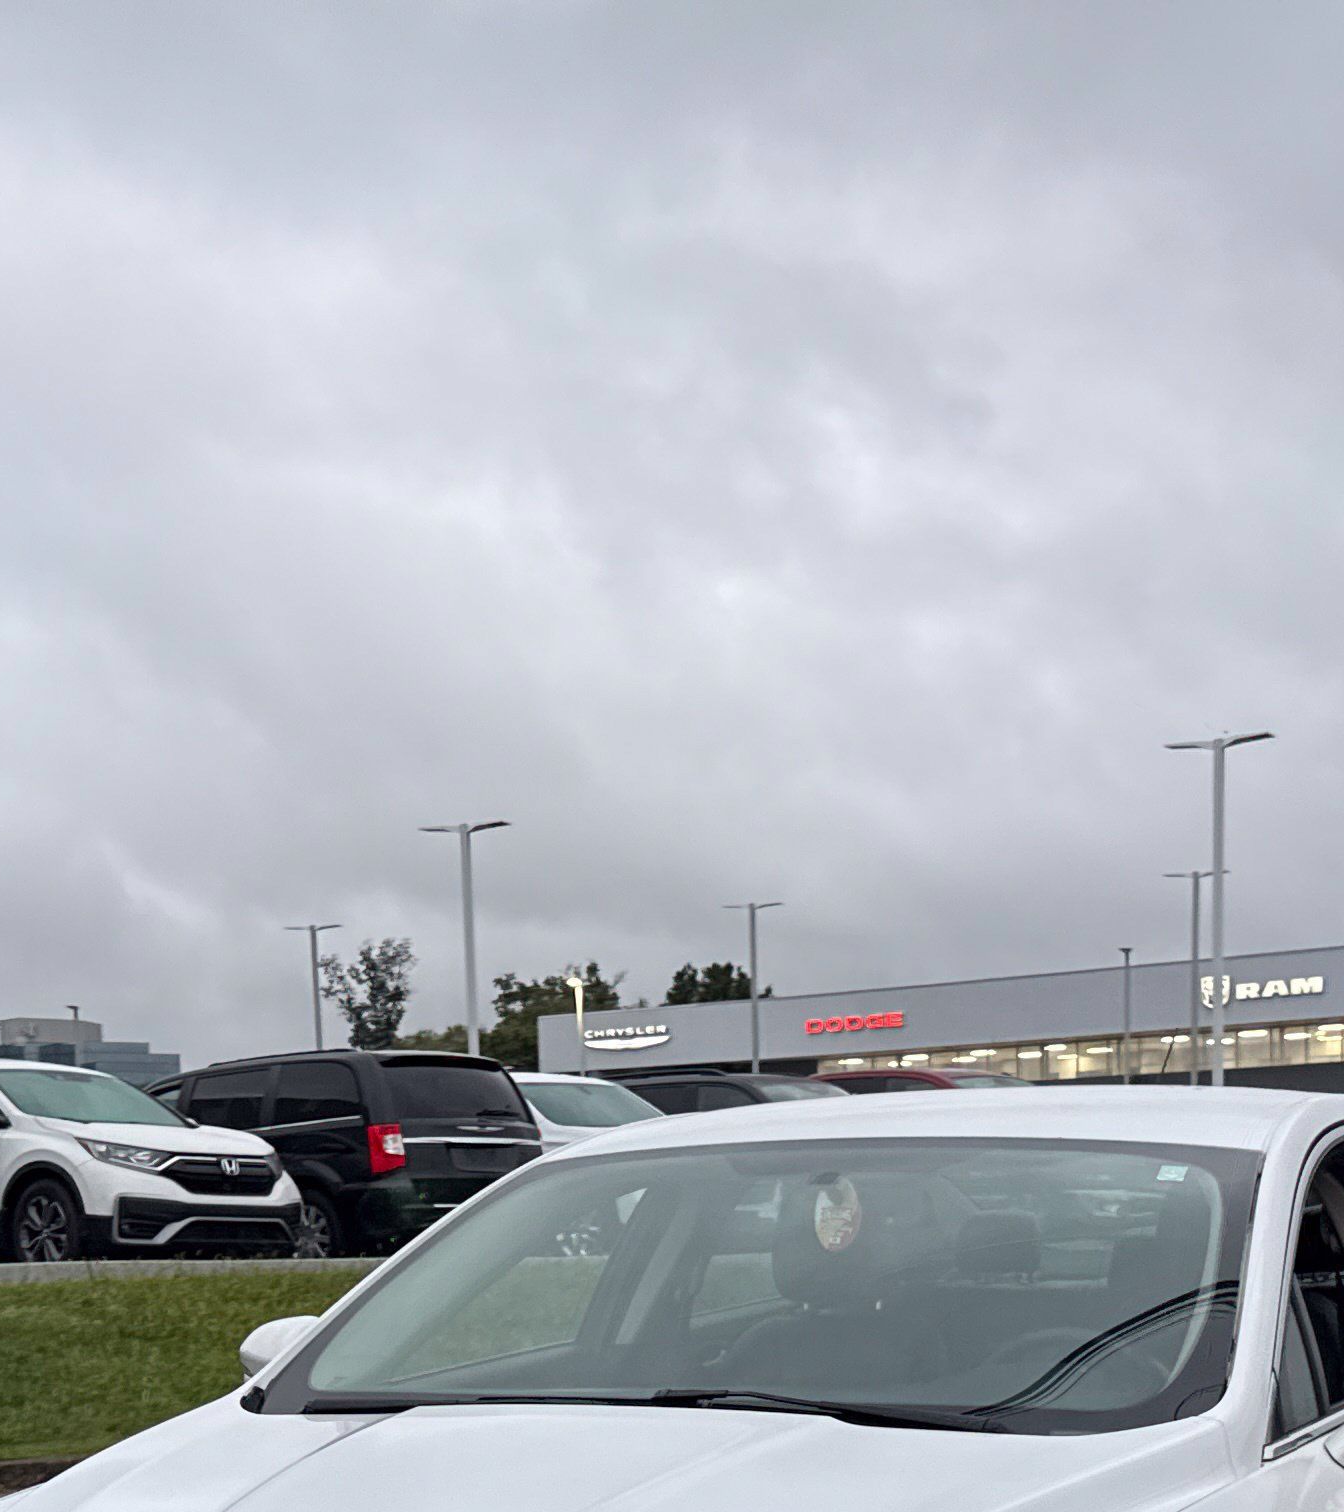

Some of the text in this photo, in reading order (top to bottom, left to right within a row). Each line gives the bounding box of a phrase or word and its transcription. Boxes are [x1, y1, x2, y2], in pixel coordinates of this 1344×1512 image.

[1236, 976, 1324, 1000] RAM
[584, 1024, 667, 1039] CHRYSLER
[805, 1011, 904, 1035] DODGE
